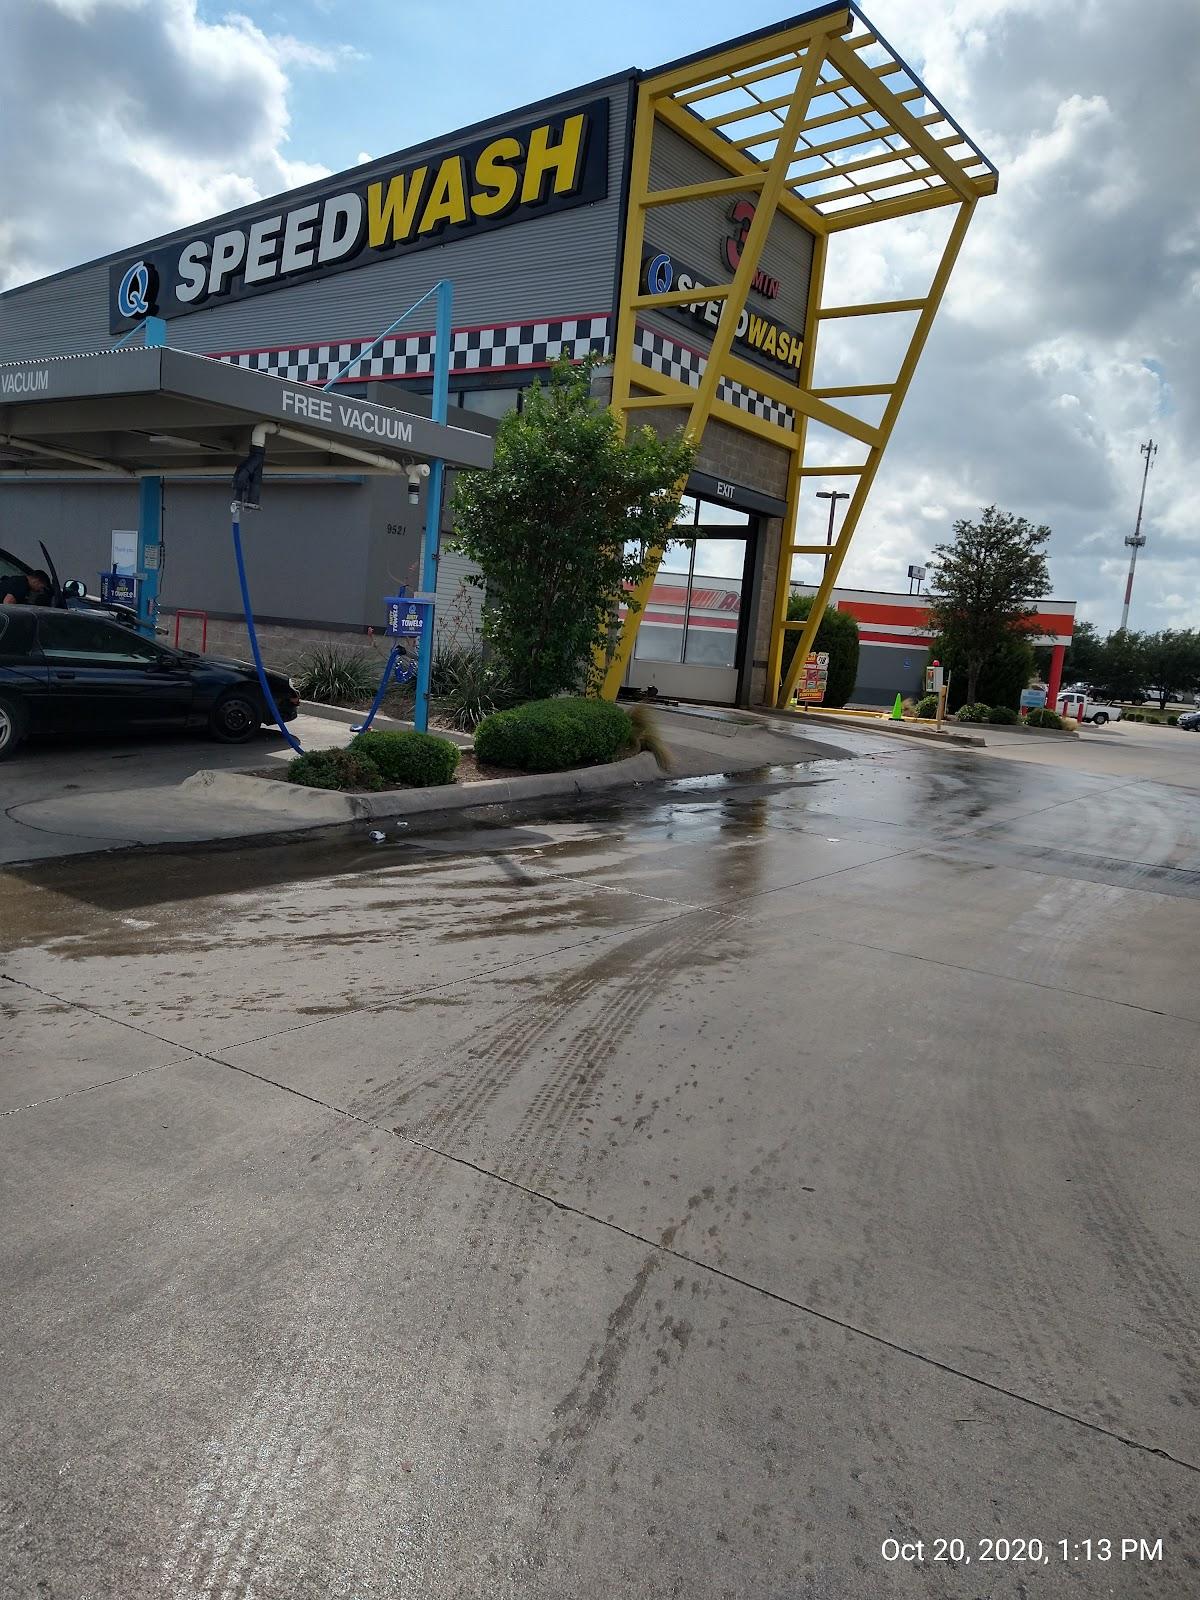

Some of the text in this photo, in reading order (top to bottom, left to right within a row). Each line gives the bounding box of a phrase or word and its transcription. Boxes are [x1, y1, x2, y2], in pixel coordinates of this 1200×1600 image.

[726, 200, 756, 271] 3
[118, 260, 149, 318] Q
[751, 270, 780, 299] MIN
[677, 273, 804, 369] SPEDWASH
[1, 370, 49, 393] VACUUM
[282, 390, 413, 443] FREE VACUUM
[716, 481, 736, 499] EXIT
[387, 523, 407, 536] 9521
[401, 619, 424, 628] TOWELS
